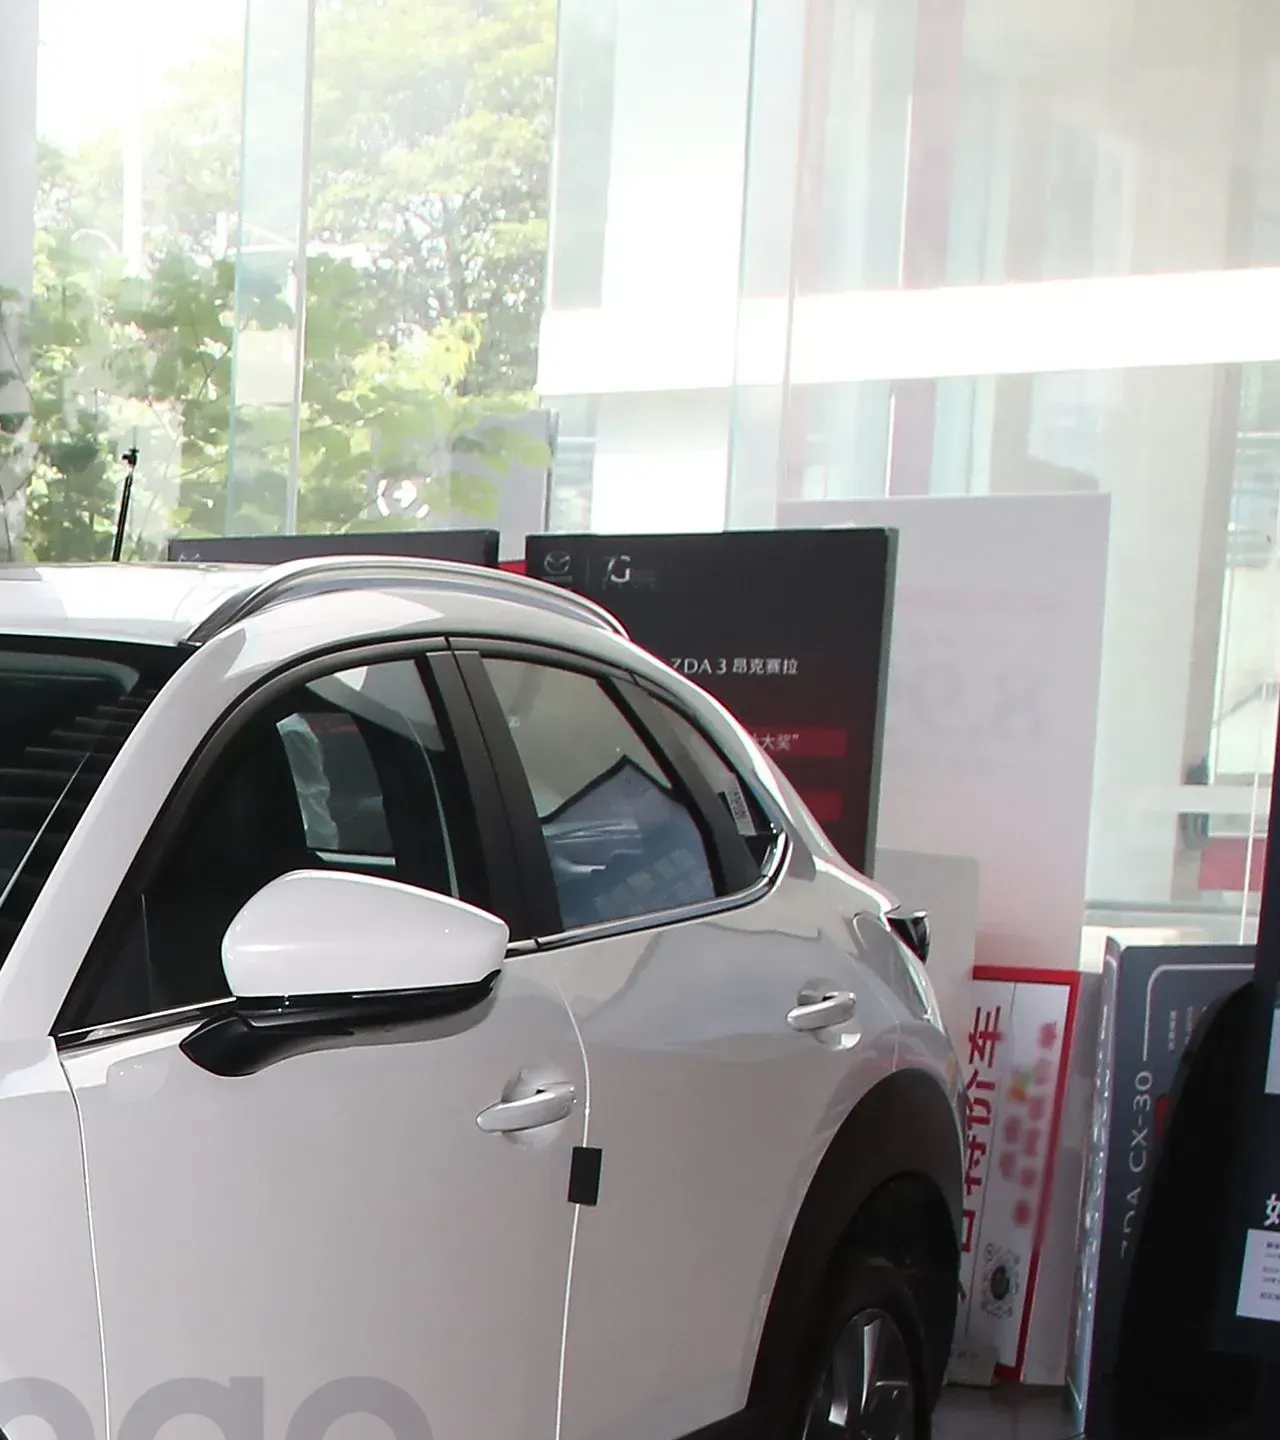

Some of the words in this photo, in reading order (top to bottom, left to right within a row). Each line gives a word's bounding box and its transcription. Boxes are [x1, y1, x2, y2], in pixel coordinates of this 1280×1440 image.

[716, 658, 727, 675] 3
[731, 658, 799, 676] 昂克赛拉
[1128, 1070, 1154, 1174] CX-30
